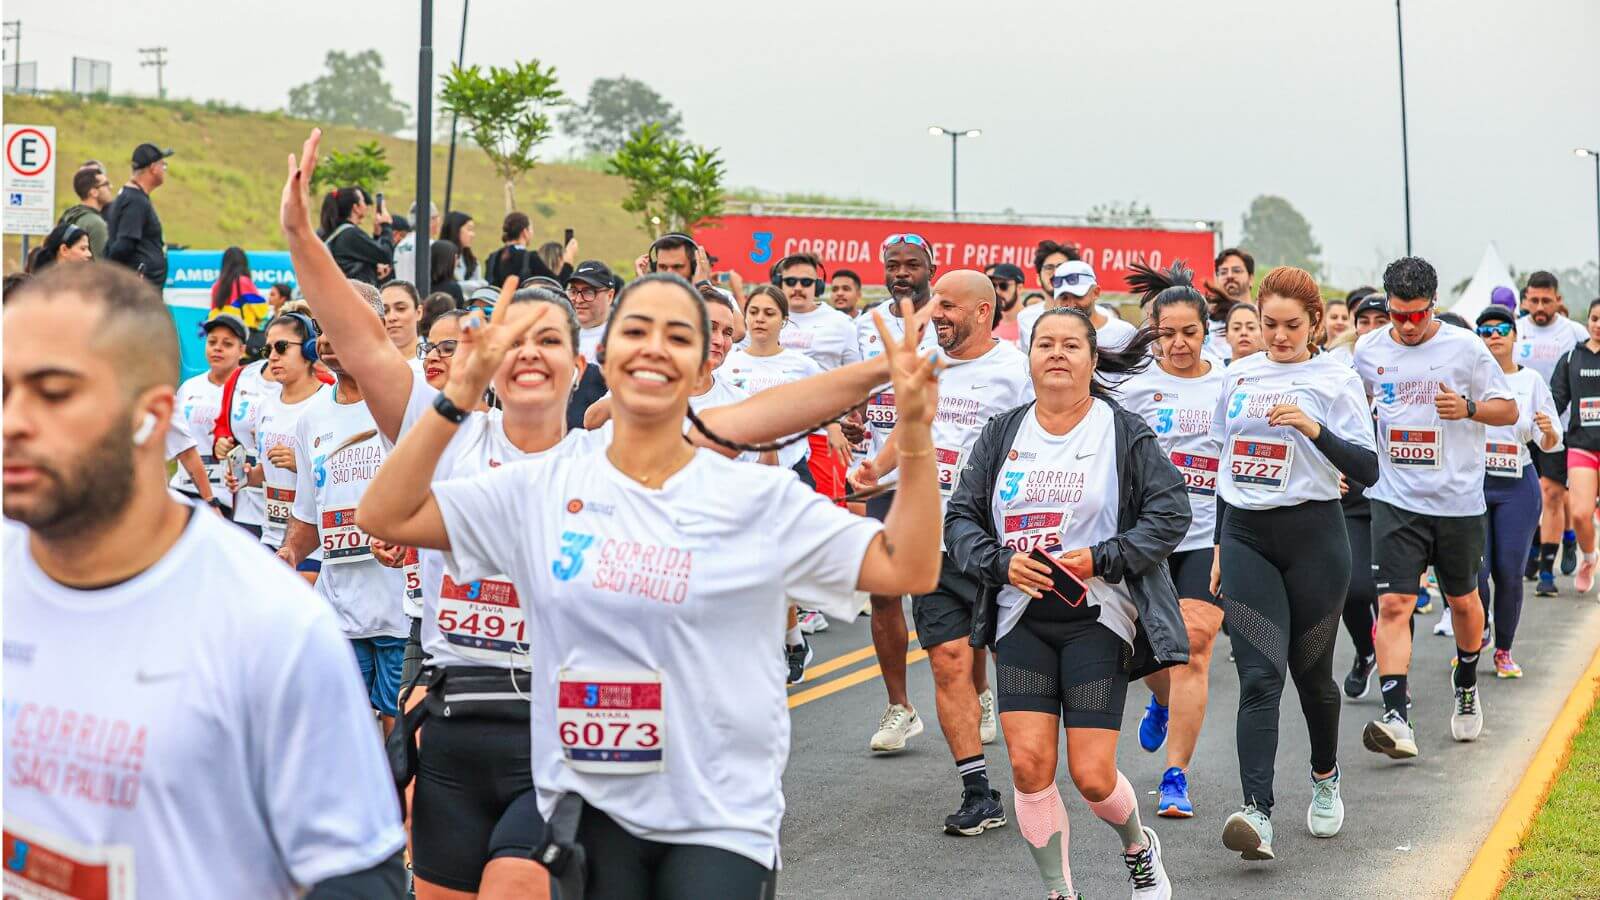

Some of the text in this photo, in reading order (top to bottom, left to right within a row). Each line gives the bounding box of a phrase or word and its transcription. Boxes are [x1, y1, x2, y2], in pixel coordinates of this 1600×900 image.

[21, 138, 37, 166] E
[750, 231, 773, 264] 3
[784, 238, 871, 263] CORRIDA
[963, 243, 1036, 269] PREMIU
[174, 268, 296, 283] AMBNCIA
[1381, 382, 1395, 404] 3
[1415, 395, 1433, 404] PAUL
[1228, 392, 1247, 418] 3
[867, 410, 896, 422] 539
[1156, 408, 1211, 433] 3 CORRI
[332, 445, 381, 465] CORRIDA
[1390, 447, 1434, 459] 5009
[1486, 457, 1517, 468] 836
[333, 468, 350, 485] SÃO
[1231, 460, 1283, 478] 5727
[1000, 470, 1084, 501] 3 CORRIDA
[1182, 472, 1216, 489] 094
[1025, 487, 1082, 503] SÃO PAULO
[267, 504, 289, 518] 583
[1005, 532, 1060, 552] 6075
[552, 530, 594, 581] 3
[601, 538, 692, 571] CORRIDA
[592, 568, 626, 593] SÃO
[628, 572, 688, 605] PAULO
[438, 609, 525, 641] 5491
[583, 684, 598, 707] 3
[559, 721, 660, 748] 6073
